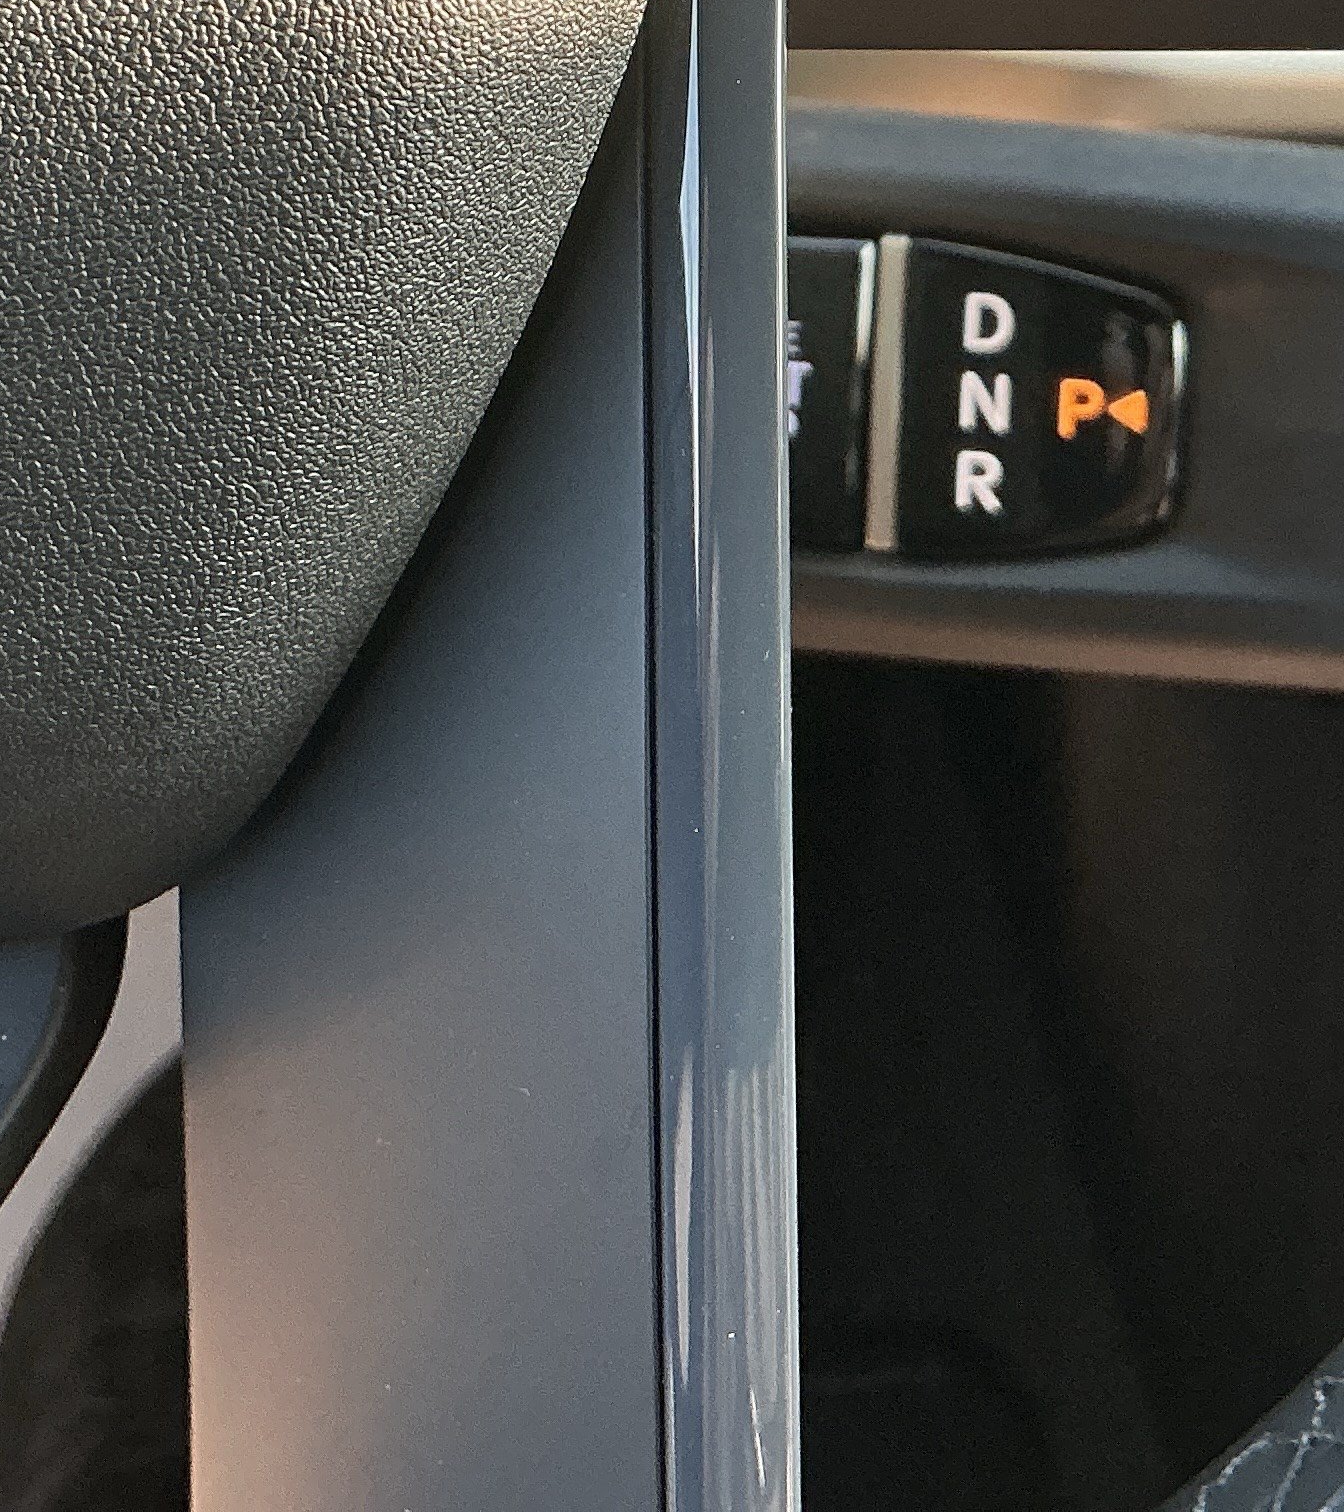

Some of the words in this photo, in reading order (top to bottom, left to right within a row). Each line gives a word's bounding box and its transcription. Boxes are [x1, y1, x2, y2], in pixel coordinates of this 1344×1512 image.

[963, 291, 1014, 354] D
[959, 371, 1012, 435] N
[1058, 378, 1105, 439] P
[955, 450, 1003, 515] R
